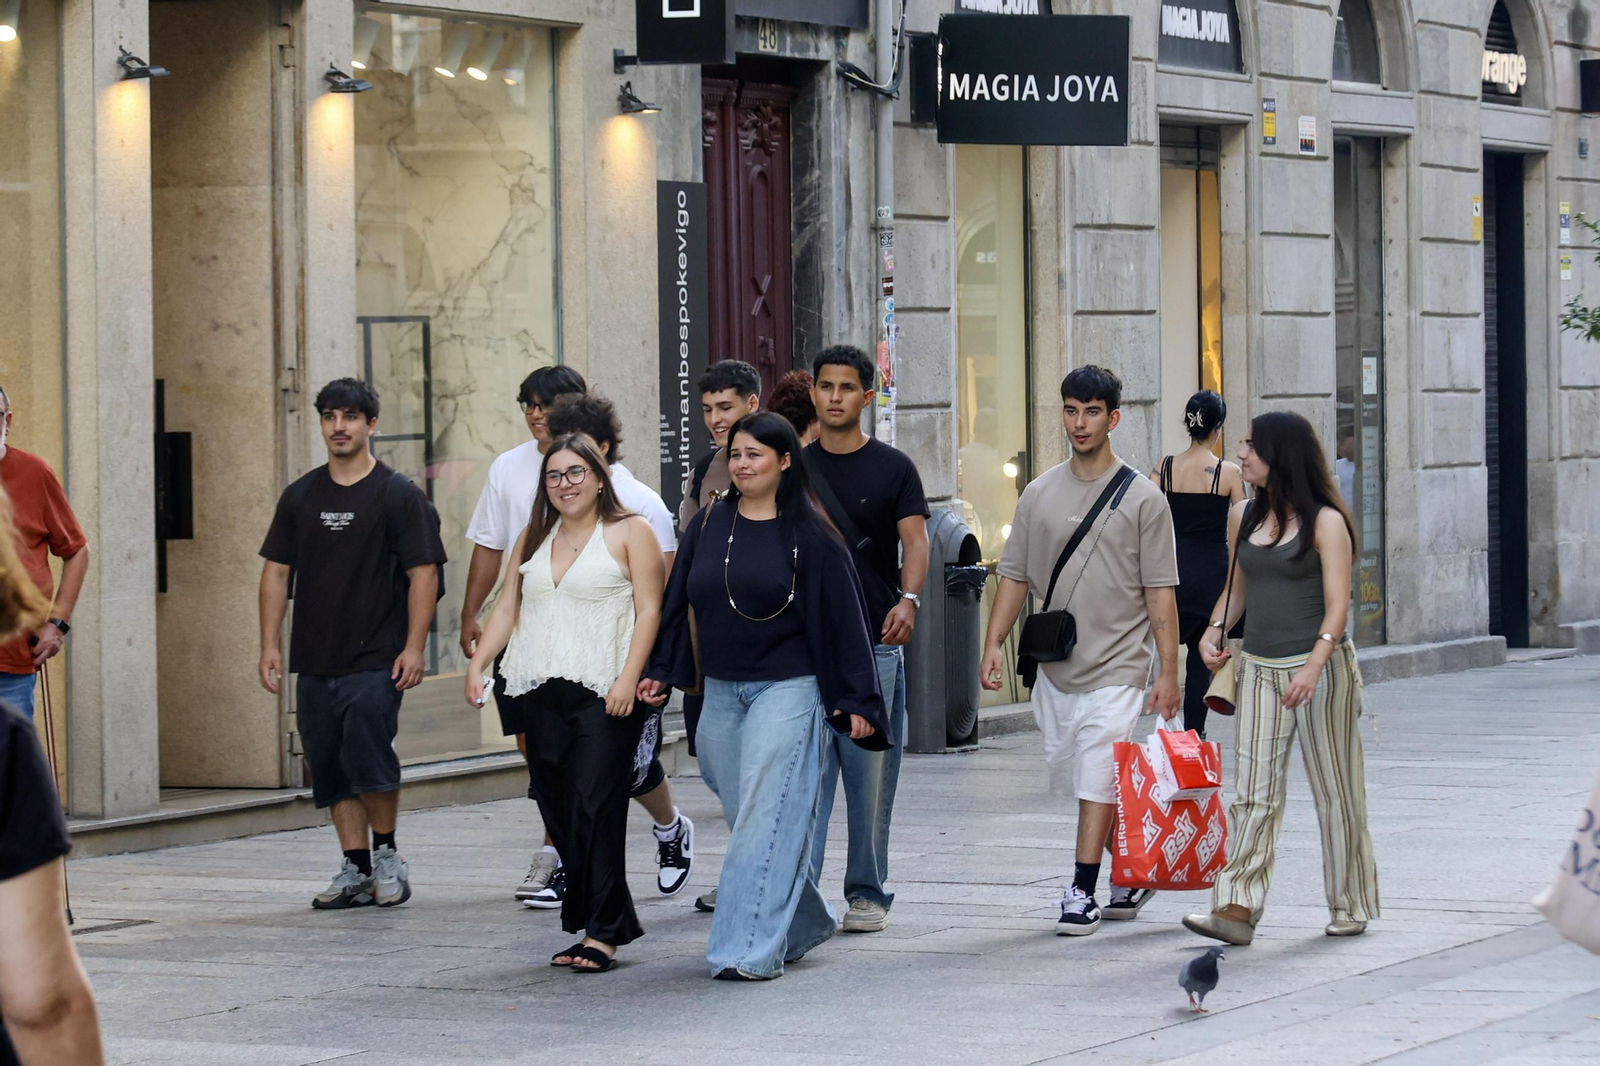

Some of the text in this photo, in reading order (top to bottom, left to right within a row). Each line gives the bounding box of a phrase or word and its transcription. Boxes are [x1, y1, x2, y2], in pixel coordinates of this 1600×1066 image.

[760, 18, 777, 49] 48
[1161, 4, 1230, 43] MAGIA JOYA
[949, 73, 1119, 102] MAGIA JOYA
